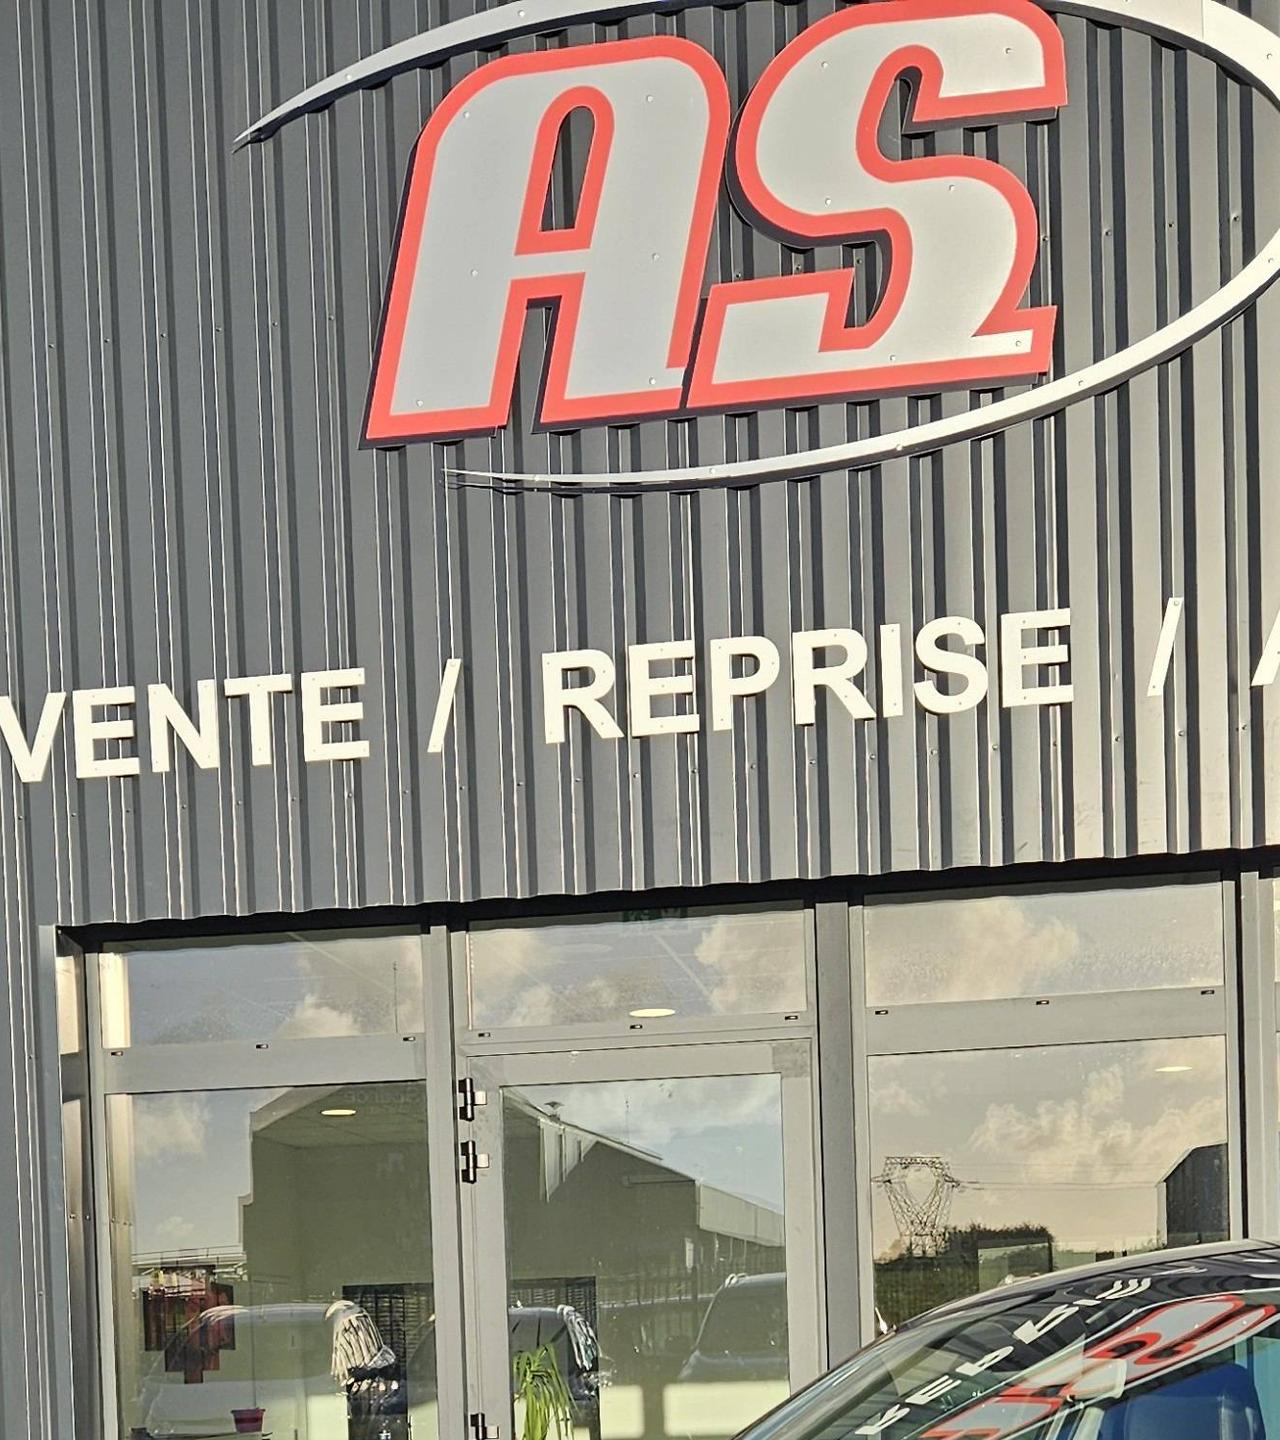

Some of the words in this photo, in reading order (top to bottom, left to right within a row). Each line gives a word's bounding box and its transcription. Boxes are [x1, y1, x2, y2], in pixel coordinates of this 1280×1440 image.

[366, 0, 1068, 440] AS
[427, 657, 462, 754] /
[541, 607, 1075, 746] REPRISE
[1146, 596, 1185, 698] /
